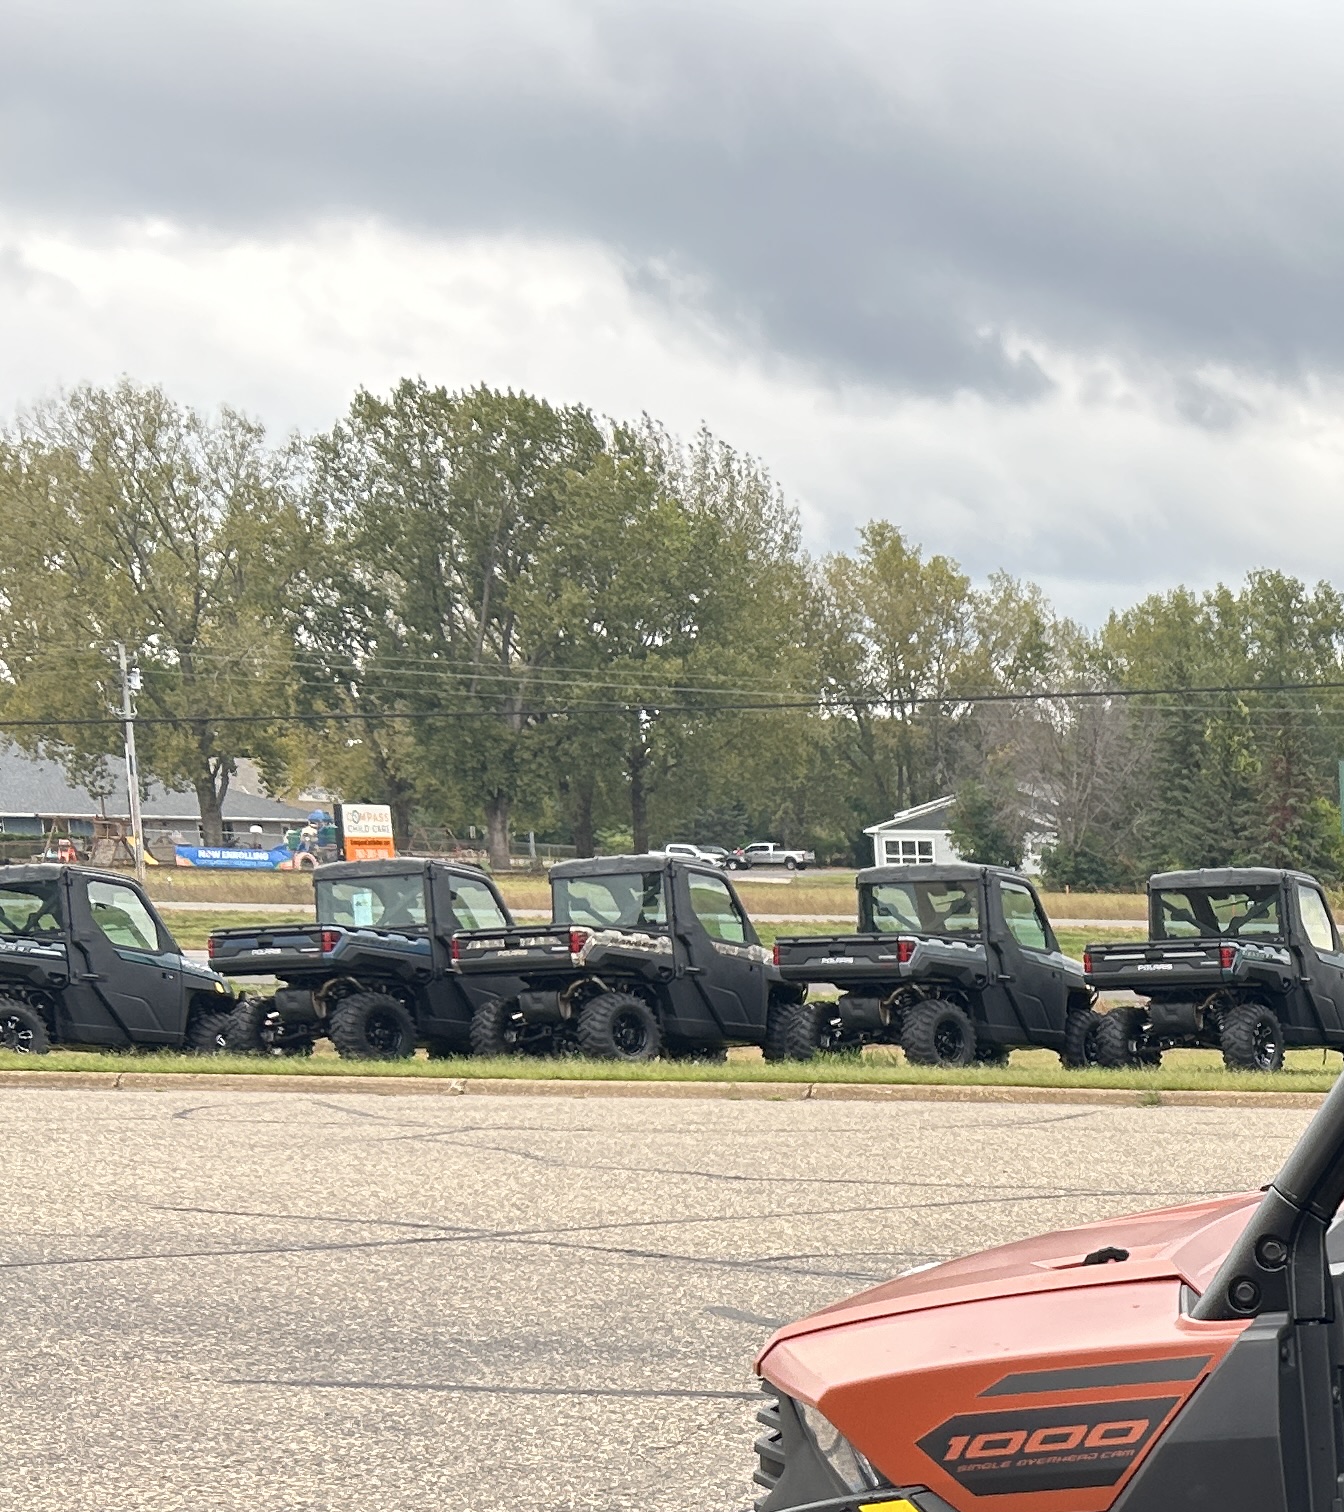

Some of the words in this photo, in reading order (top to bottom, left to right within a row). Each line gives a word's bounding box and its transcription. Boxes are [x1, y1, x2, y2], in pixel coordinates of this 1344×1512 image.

[346, 809, 389, 824] COMPASS
[197, 849, 220, 859] NOW
[221, 850, 269, 861] ENROLLING
[1137, 963, 1173, 971] POLARIS
[943, 1418, 1149, 1461] 1000
[956, 1460, 1011, 1473] SINGLE
[1016, 1452, 1098, 1467] OVERHEAD
[1100, 1449, 1135, 1459] CAM
